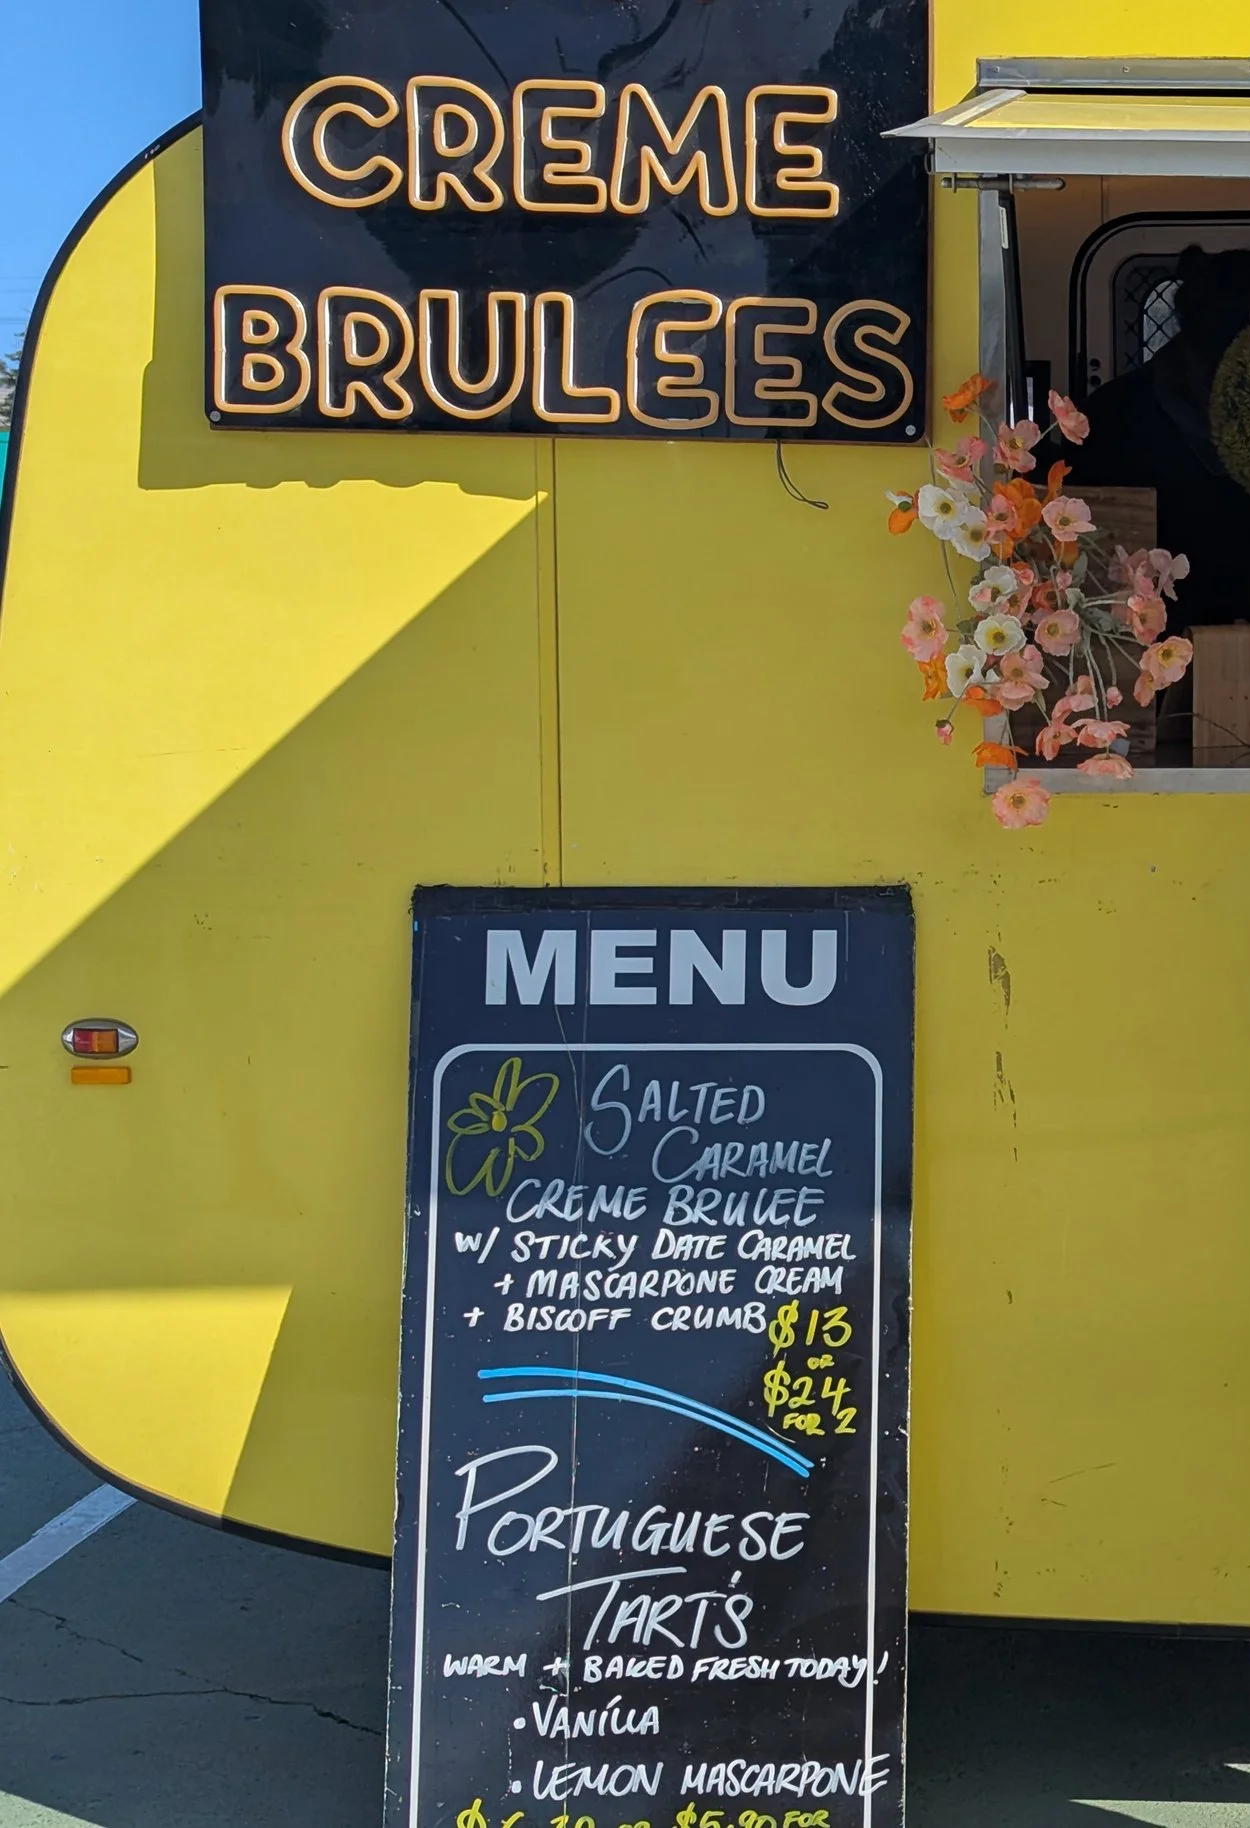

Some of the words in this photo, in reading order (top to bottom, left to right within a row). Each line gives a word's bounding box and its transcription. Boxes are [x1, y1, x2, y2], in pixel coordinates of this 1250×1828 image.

[281, 75, 840, 218] CREME
[213, 284, 915, 429] BRULEES
[484, 929, 838, 1006] MENU
[584, 1064, 766, 1156] SALTED
[652, 1125, 833, 1184] CARAMEL
[506, 1178, 648, 1224] CREME
[662, 1184, 825, 1227] BRULEE
[511, 1231, 639, 1272] STICKY
[651, 1228, 728, 1260] DATE
[737, 1229, 857, 1262] CARAMEL
[526, 1265, 737, 1301] MASCARPONE
[755, 1265, 844, 1295] CREAM
[503, 1303, 632, 1332] BISCOFF
[651, 1302, 767, 1333] CRUMB
[768, 1299, 853, 1358] $13
[763, 1360, 851, 1418] $24
[783, 1413, 826, 1436] FOR
[834, 1407, 857, 1434] 2
[454, 1444, 811, 1561] PORTUGUESE
[443, 1653, 528, 1678] WARM
[583, 1655, 685, 1683] BAKED
[690, 1655, 781, 1683] FRESH
[533, 1759, 664, 1801] LEMON
[680, 1752, 890, 1798] MASCARPONE
